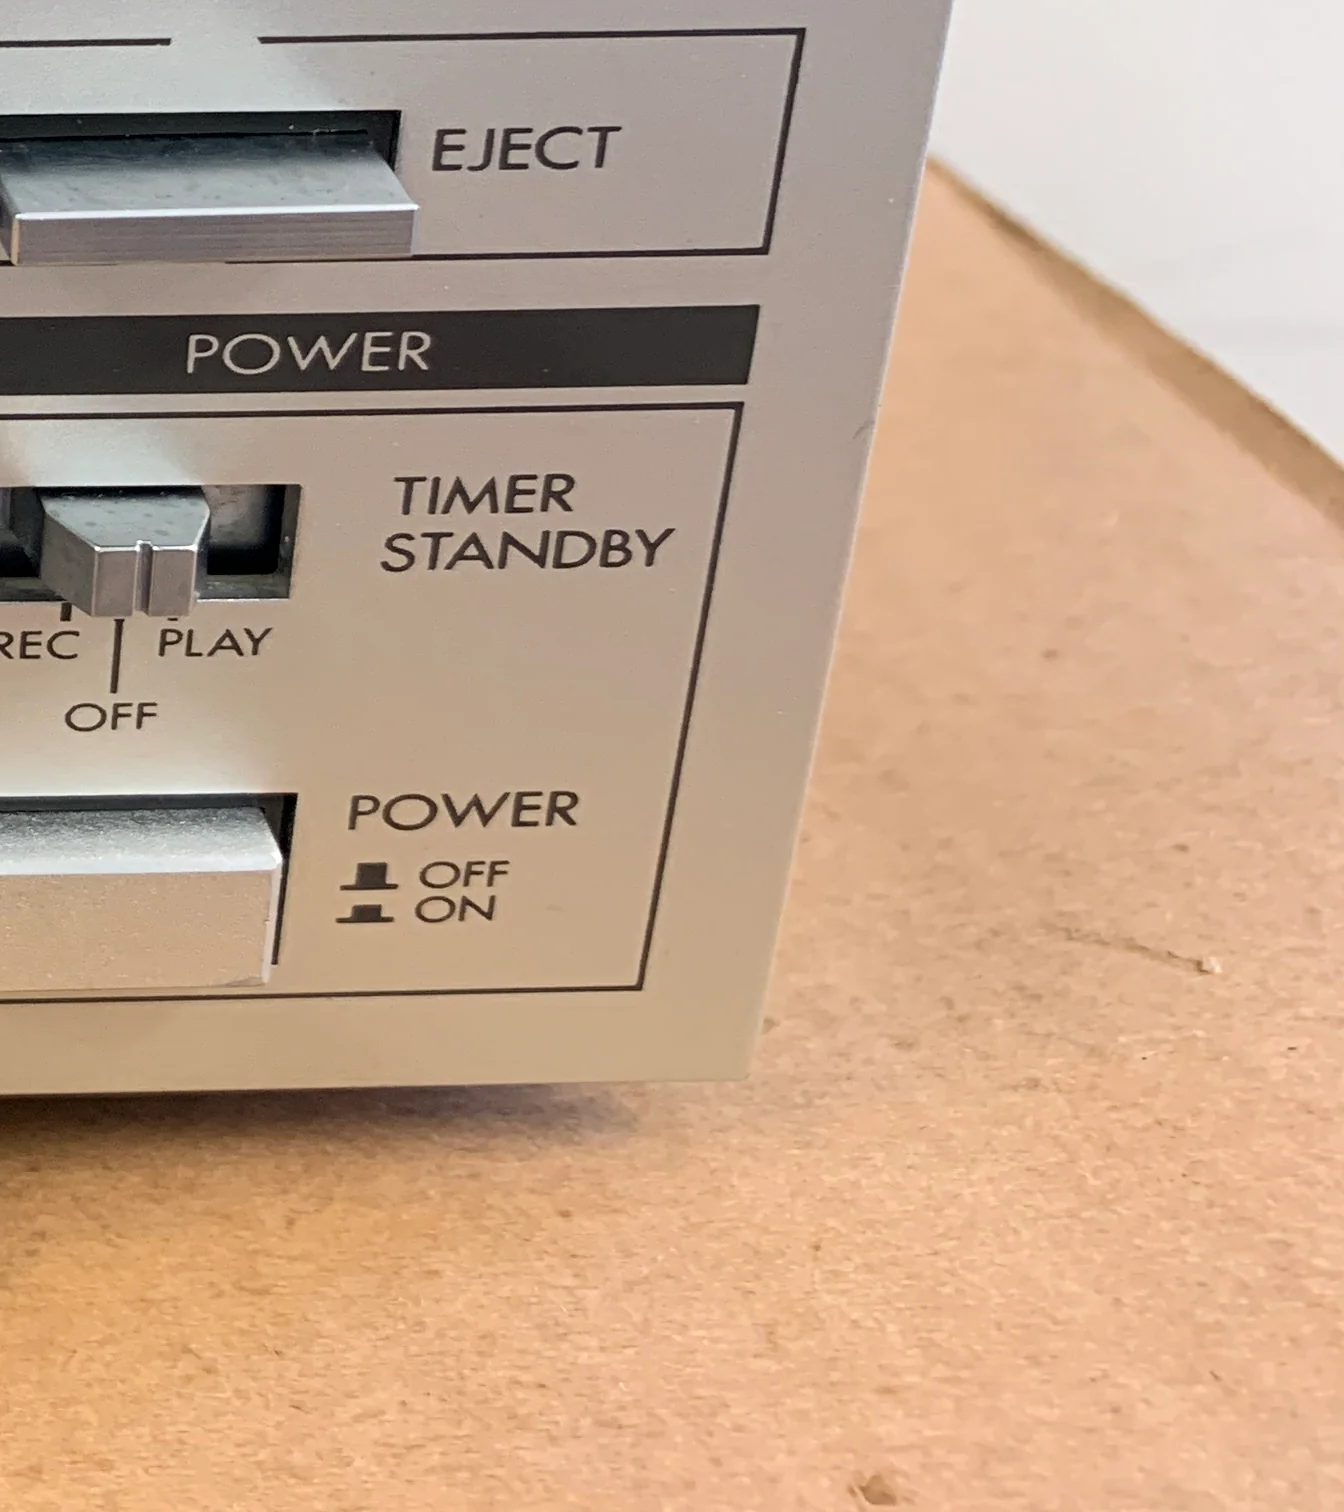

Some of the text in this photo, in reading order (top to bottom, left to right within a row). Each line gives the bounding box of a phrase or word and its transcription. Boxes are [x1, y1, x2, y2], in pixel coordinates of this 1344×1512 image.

[432, 126, 622, 172] EJECT
[186, 331, 434, 376] POWER
[393, 474, 576, 516] TIMER
[378, 528, 676, 573] STANDBY
[157, 628, 274, 657] PLAY
[64, 702, 159, 733] OFF
[347, 792, 580, 830] POWER
[419, 860, 510, 889] OFF
[414, 897, 498, 922] ON
